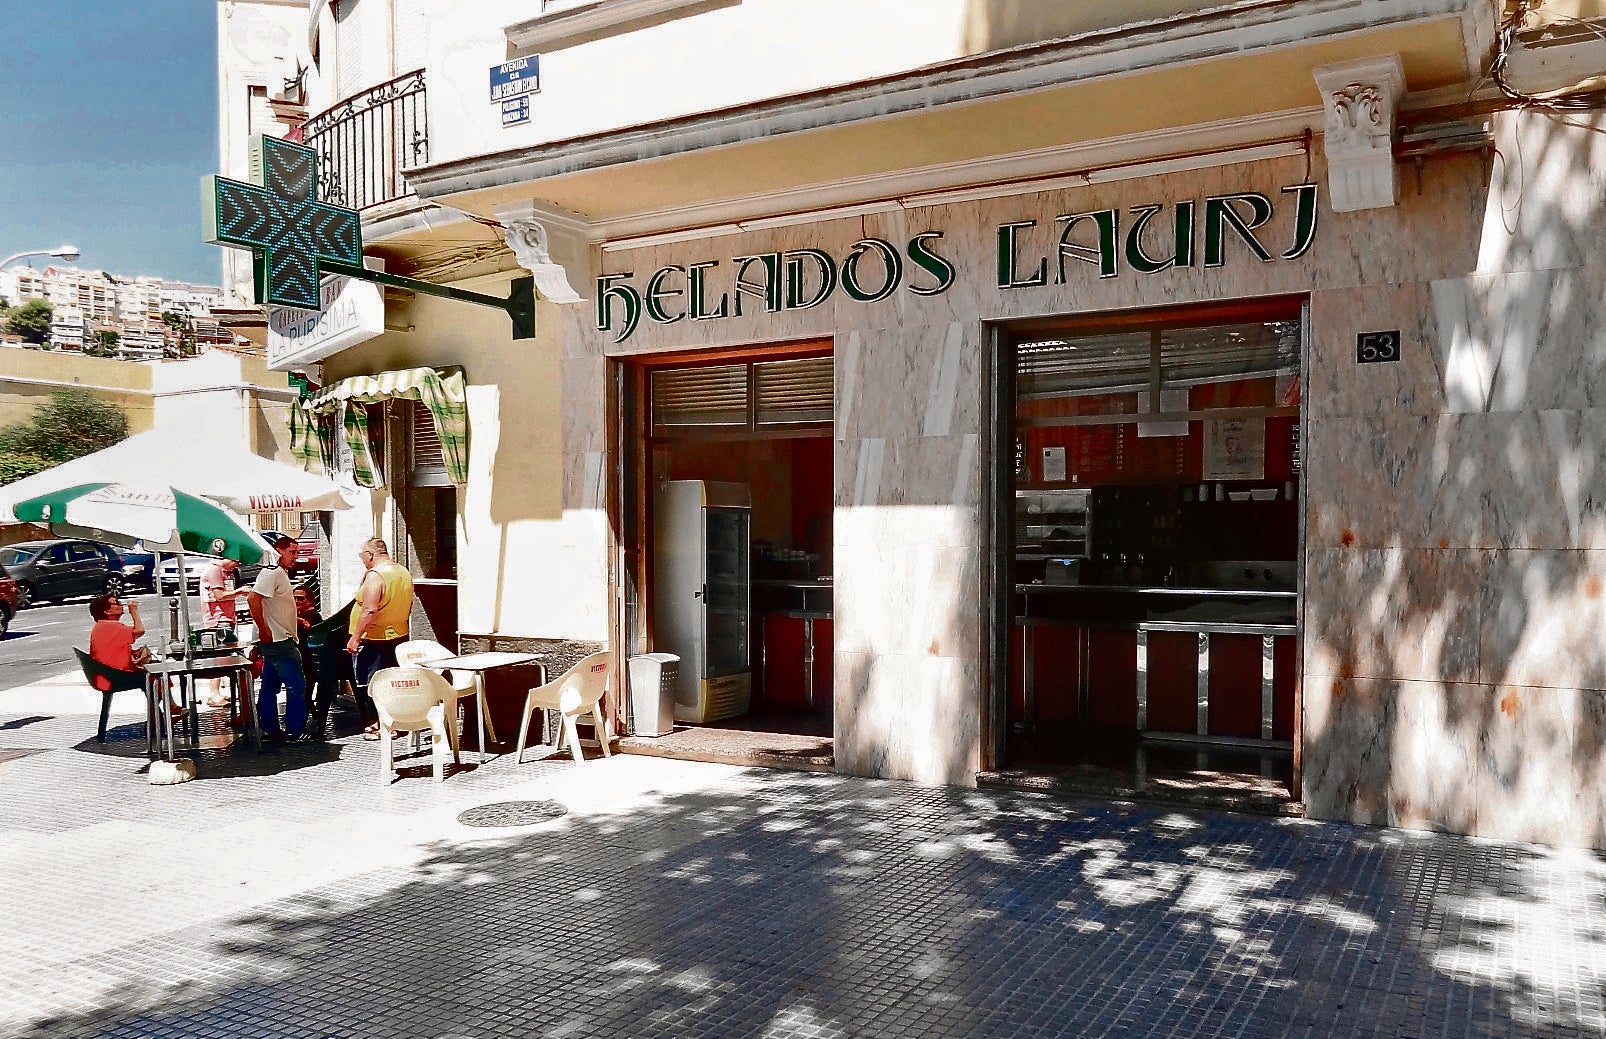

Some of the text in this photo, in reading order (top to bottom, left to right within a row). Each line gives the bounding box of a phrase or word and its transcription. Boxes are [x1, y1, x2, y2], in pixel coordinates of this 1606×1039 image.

[500, 58, 529, 74] AVENIDA
[596, 230, 955, 343] HELADOS
[1363, 334, 1395, 360] 53
[249, 494, 302, 509] VICTORIA
[390, 679, 420, 688] VICTORIA
